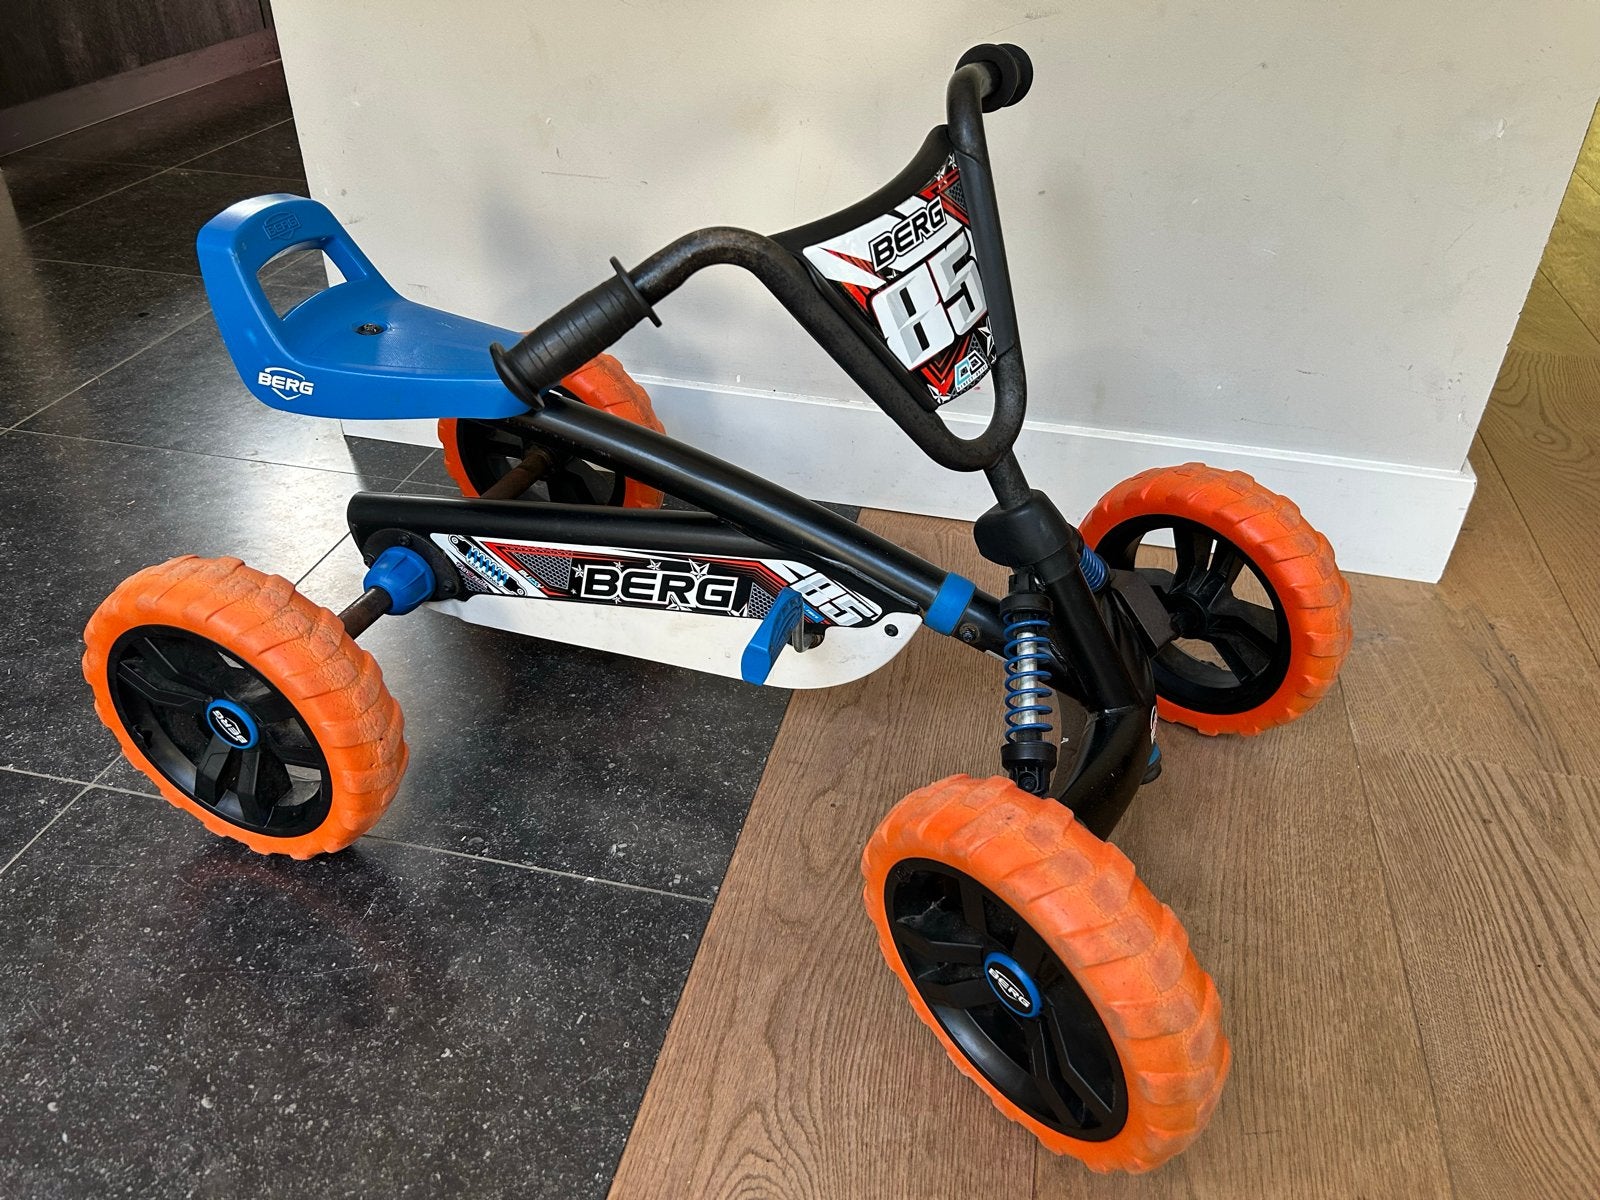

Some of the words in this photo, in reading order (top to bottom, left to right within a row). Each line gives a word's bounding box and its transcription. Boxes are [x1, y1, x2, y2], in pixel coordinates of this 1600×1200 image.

[869, 198, 946, 271] BERG
[871, 230, 988, 371] 85
[258, 371, 314, 396] BERG
[581, 565, 738, 611] BERG
[789, 572, 876, 626] 85
[212, 710, 248, 743] BERG
[988, 968, 1031, 1008] BERG
